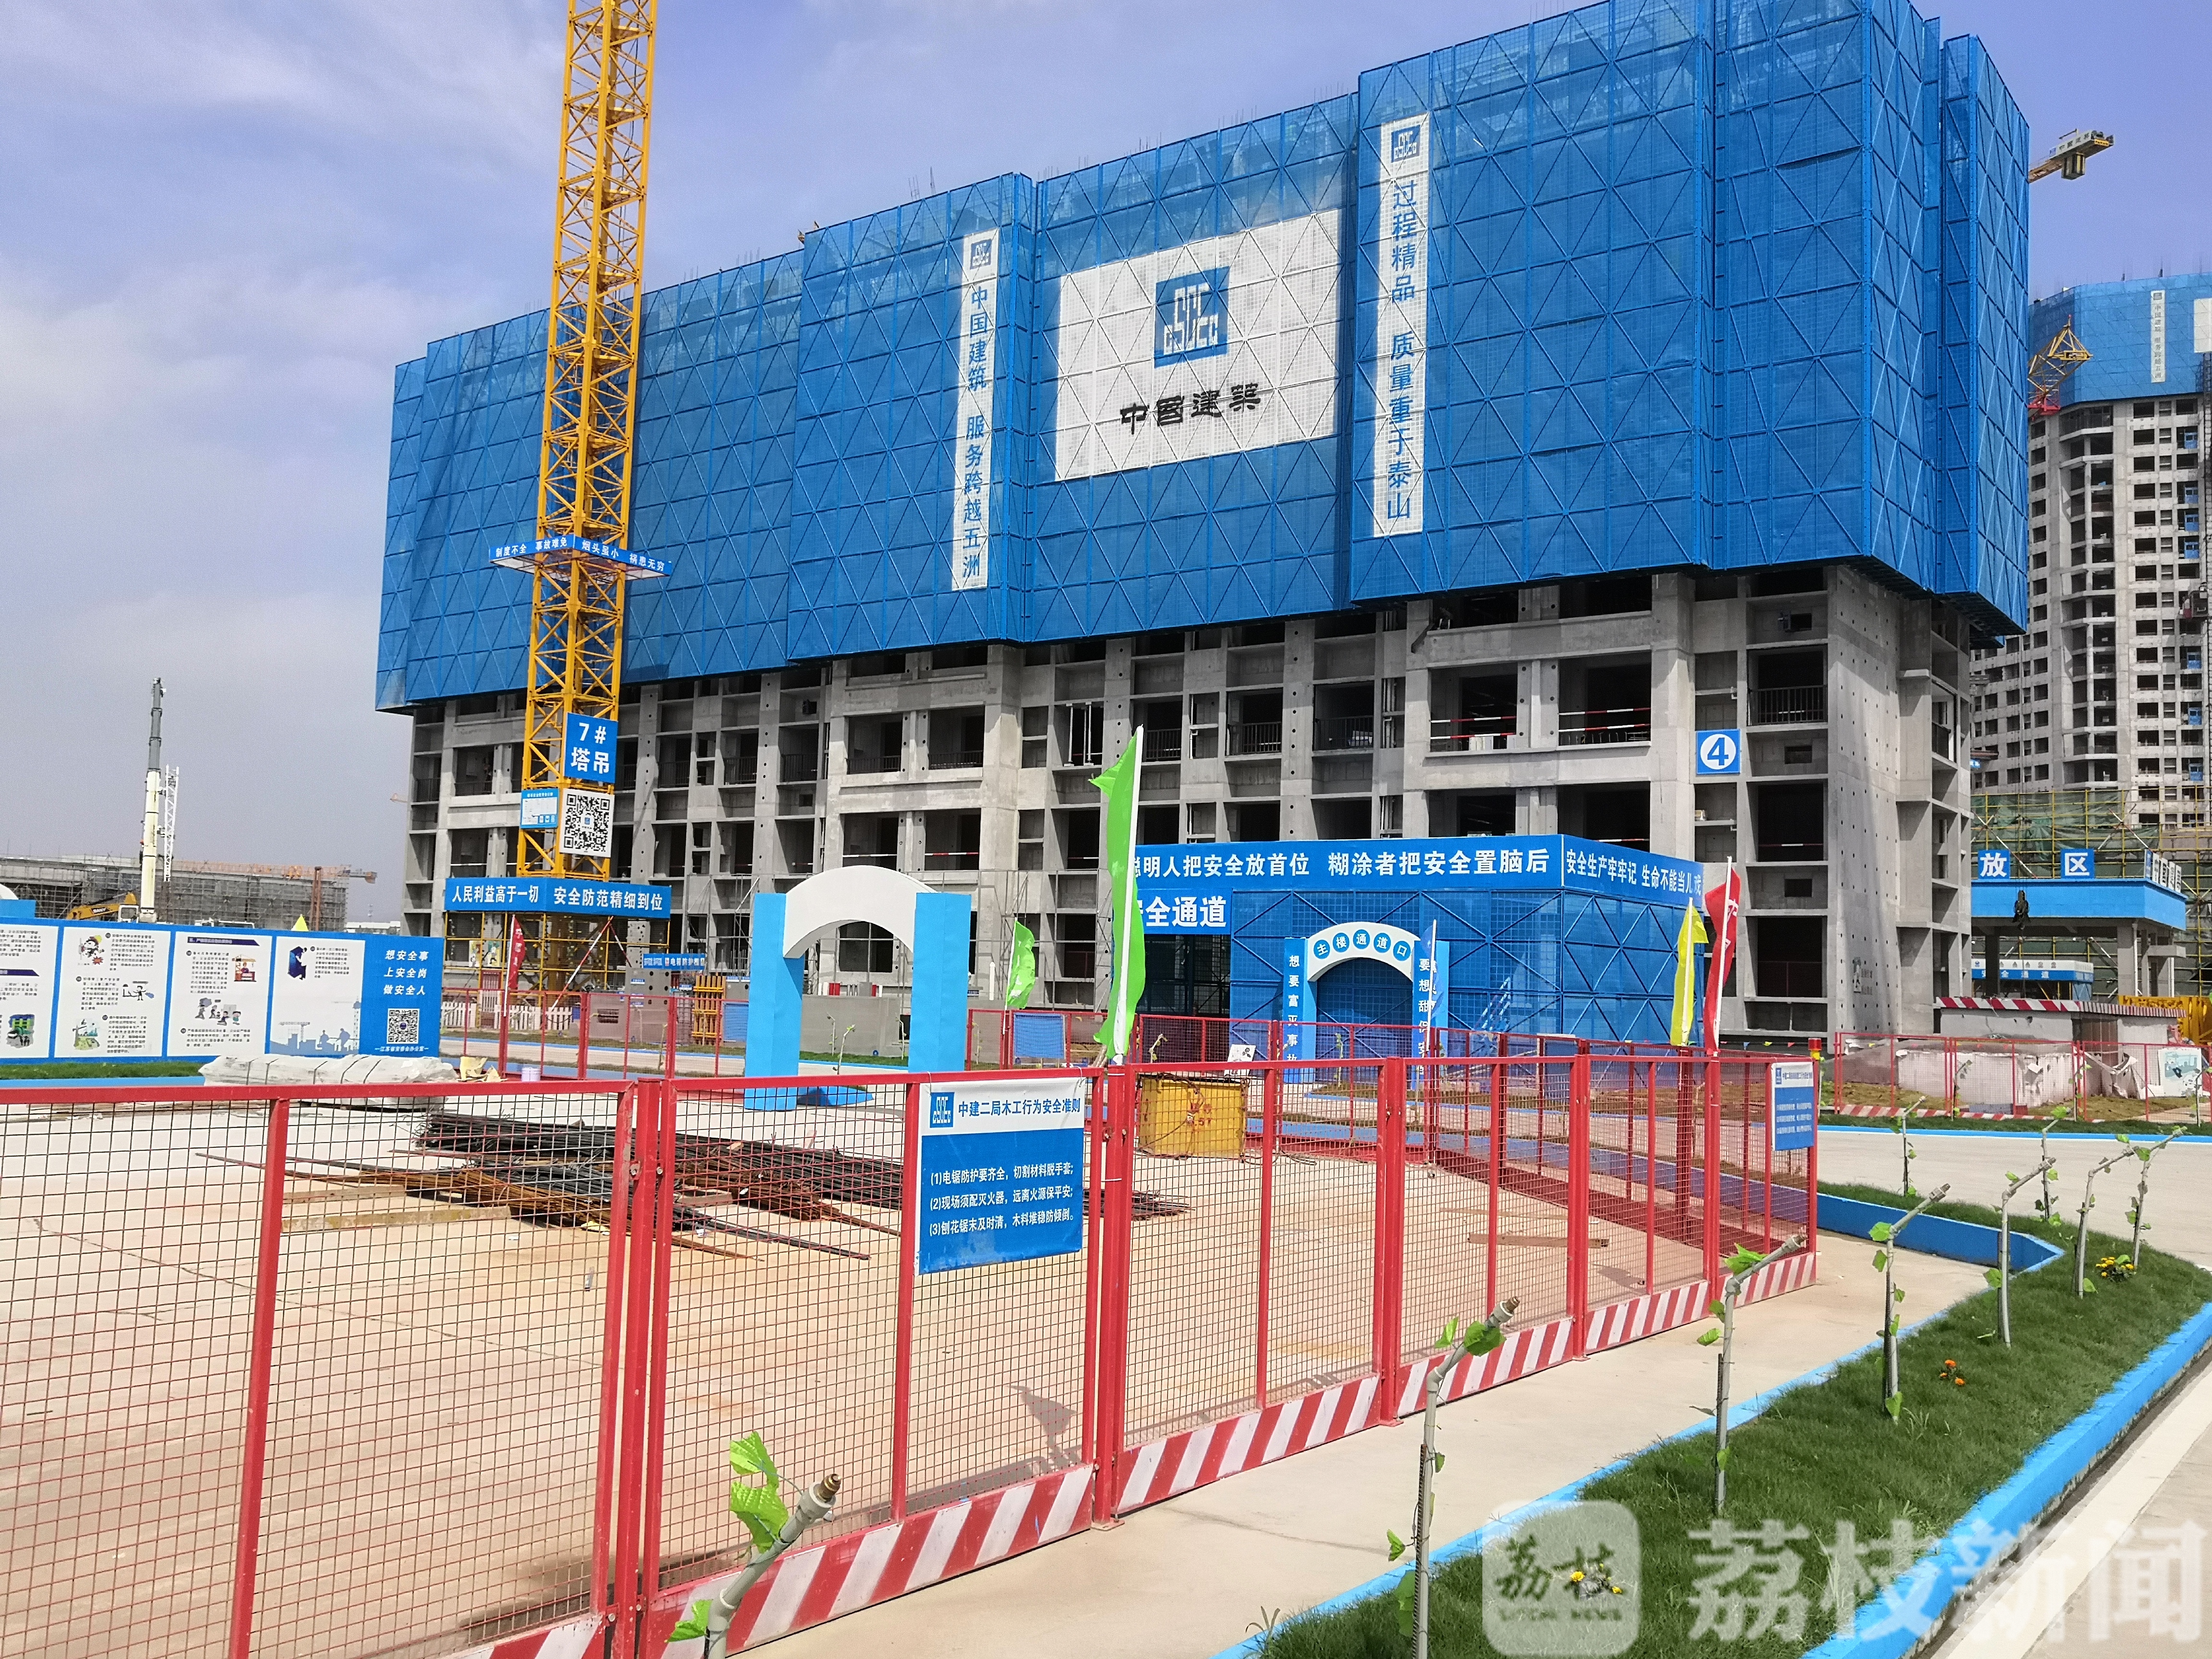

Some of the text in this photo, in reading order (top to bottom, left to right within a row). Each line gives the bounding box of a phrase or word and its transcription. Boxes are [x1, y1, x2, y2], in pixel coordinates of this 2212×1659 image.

[1387, 180, 1418, 519] 过程精品 质量重于泰山
[962, 286, 987, 578] 中国建筑 服务跨越五洲
[495, 536, 567, 558] 制度不全 事故难免
[581, 540, 665, 572] 烟头虽小 祸患无穷
[579, 722, 607, 744] 7#
[570, 746, 610, 774] 塔吊
[1707, 737, 1729, 766] 4
[1328, 848, 1550, 876] 糊涂者把安全置脑后
[1566, 848, 1702, 896] 安全生产牢牢记 生命不能当儿戏
[452, 885, 663, 911] 人民利益高于一切 安全防范精细到位
[1137, 895, 1227, 928] 全通道
[385, 949, 429, 962] 想安全事
[1316, 932, 1407, 957] 主楼通道口
[383, 985, 426, 996] 做安全人
[958, 1098, 1081, 1118] 中建二局木工行为安全准则
